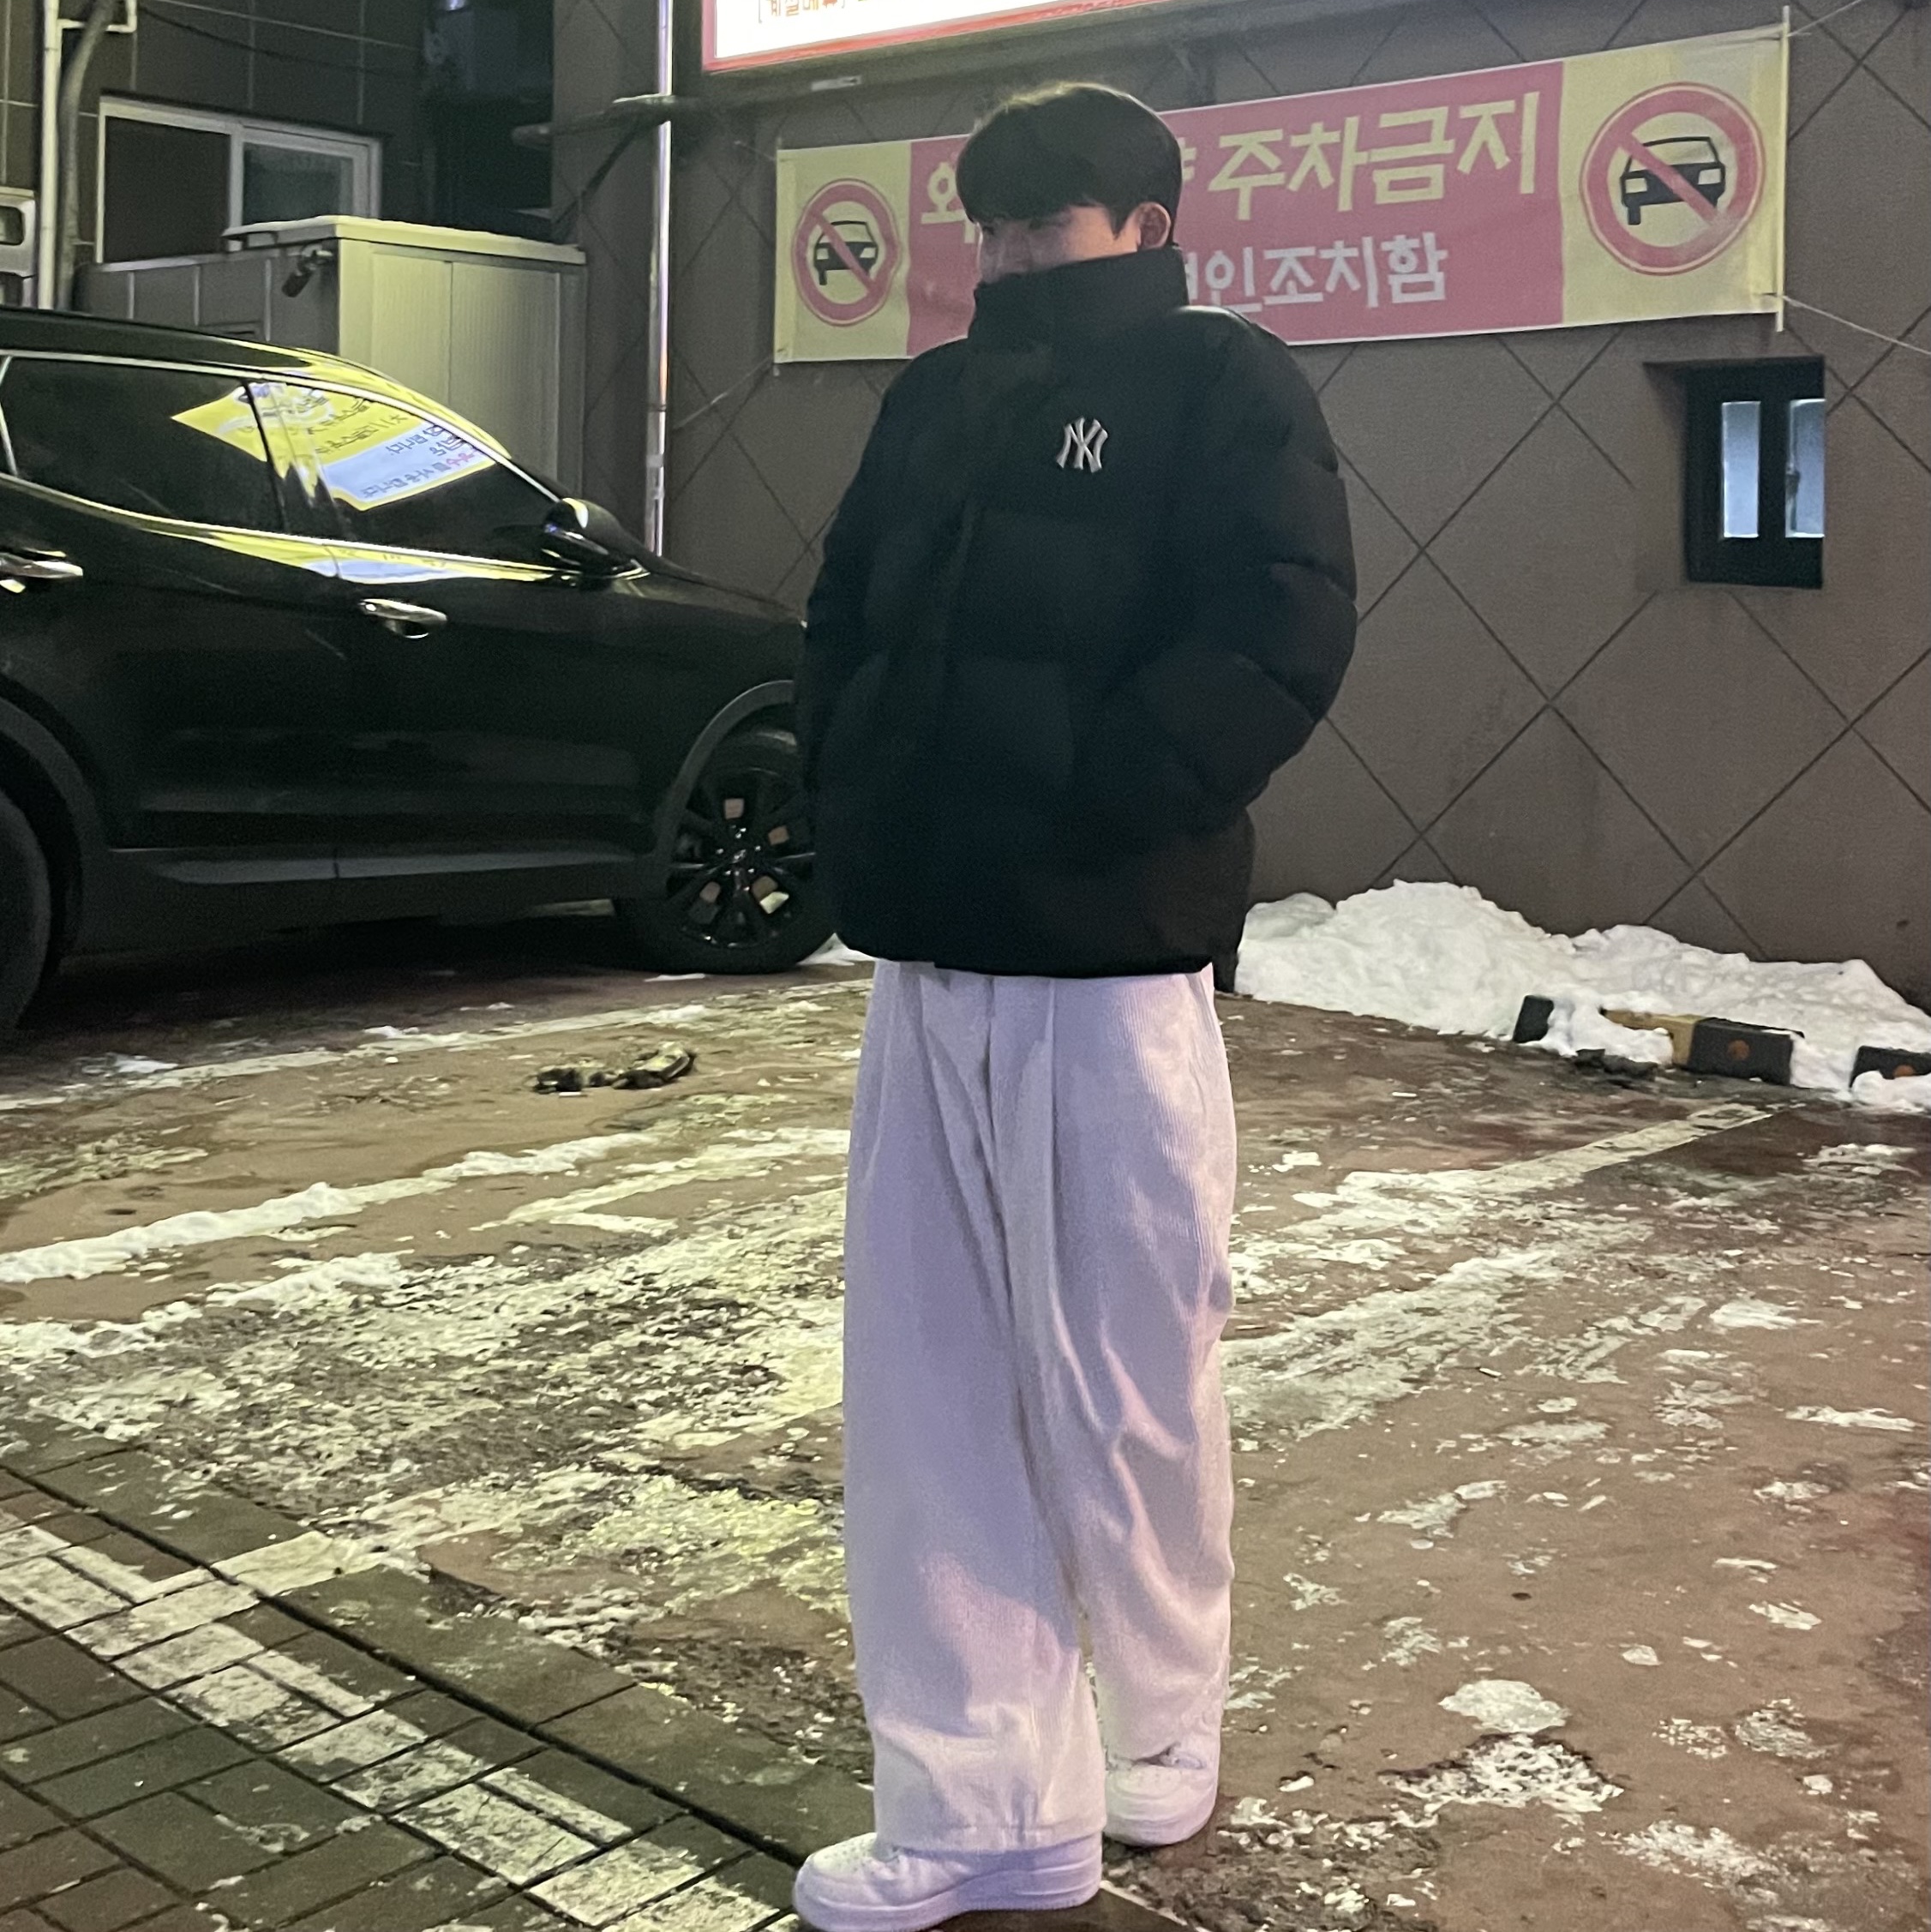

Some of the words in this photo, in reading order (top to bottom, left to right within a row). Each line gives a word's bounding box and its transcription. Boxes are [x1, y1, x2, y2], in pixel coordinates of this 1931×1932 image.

[1208, 91, 1541, 221] 주차금지
[1184, 231, 1448, 314] 인조치함
[1056, 417, 1108, 473] NY
